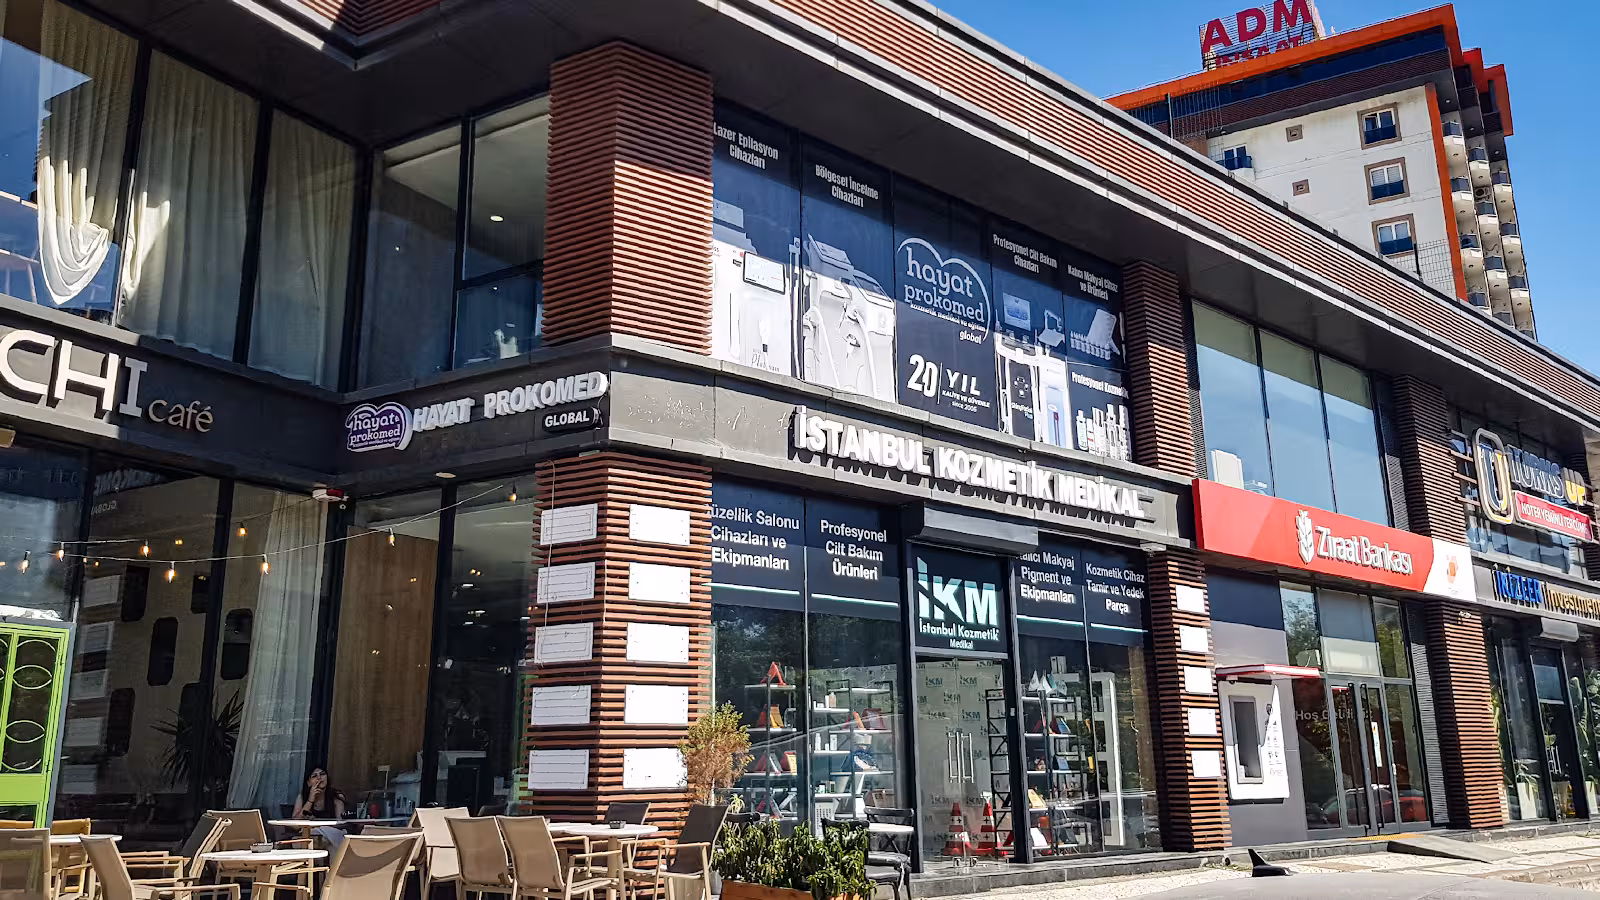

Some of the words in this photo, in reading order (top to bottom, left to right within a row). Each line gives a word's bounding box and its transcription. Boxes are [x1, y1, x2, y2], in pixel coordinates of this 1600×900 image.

[1202, 0, 1313, 53] ADM
[713, 122, 736, 142] Lazer
[738, 132, 779, 160] Epilasyon
[729, 144, 766, 170] Cihazları
[815, 164, 849, 188] Bölgesel
[849, 175, 879, 200] İncelme
[831, 185, 864, 208] Cihazları
[992, 233, 1029, 257] Profesyonel
[1039, 252, 1058, 269] Bakım
[906, 246, 973, 298] hayat
[904, 284, 985, 323] prokomed
[960, 330, 982, 344] global
[906, 354, 938, 397] 20
[946, 368, 981, 396] YIL
[413, 397, 475, 432] HAYAT
[484, 371, 609, 418] PROKOMED
[148, 400, 214, 433] café
[353, 413, 395, 433] hayat
[545, 410, 590, 428] GLOBAL
[349, 424, 400, 446] prokomed
[796, 405, 931, 476] İSTANBUL
[933, 446, 1053, 500] KOZMETİK
[1055, 472, 1146, 518] MEDİKAL
[756, 510, 800, 530] Salonu
[820, 519, 887, 543] Profesyonel
[711, 525, 769, 548] Cihazları
[771, 536, 787, 549] ve
[711, 547, 790, 571] Ekipmanları
[825, 540, 847, 557] Cilt
[848, 543, 884, 562] Bakım
[1042, 551, 1075, 571] Makyaj
[1314, 525, 1361, 564] Ziraat
[1360, 535, 1413, 574] Bankası
[832, 558, 879, 581] Ürünleri
[1020, 565, 1060, 584] Pigment
[1060, 574, 1072, 586] ve
[1085, 562, 1123, 581] Kozmetik
[1124, 567, 1145, 584] Cihaz
[1020, 583, 1075, 604] Ekipmanları
[1086, 578, 1109, 595] Tamir
[1109, 585, 1120, 596] ve
[1120, 583, 1145, 600] Yedek
[1105, 598, 1129, 614] Parça
[919, 617, 956, 637] İstanbul
[957, 624, 998, 641] Kozmetik
[949, 638, 974, 650] Medikal
